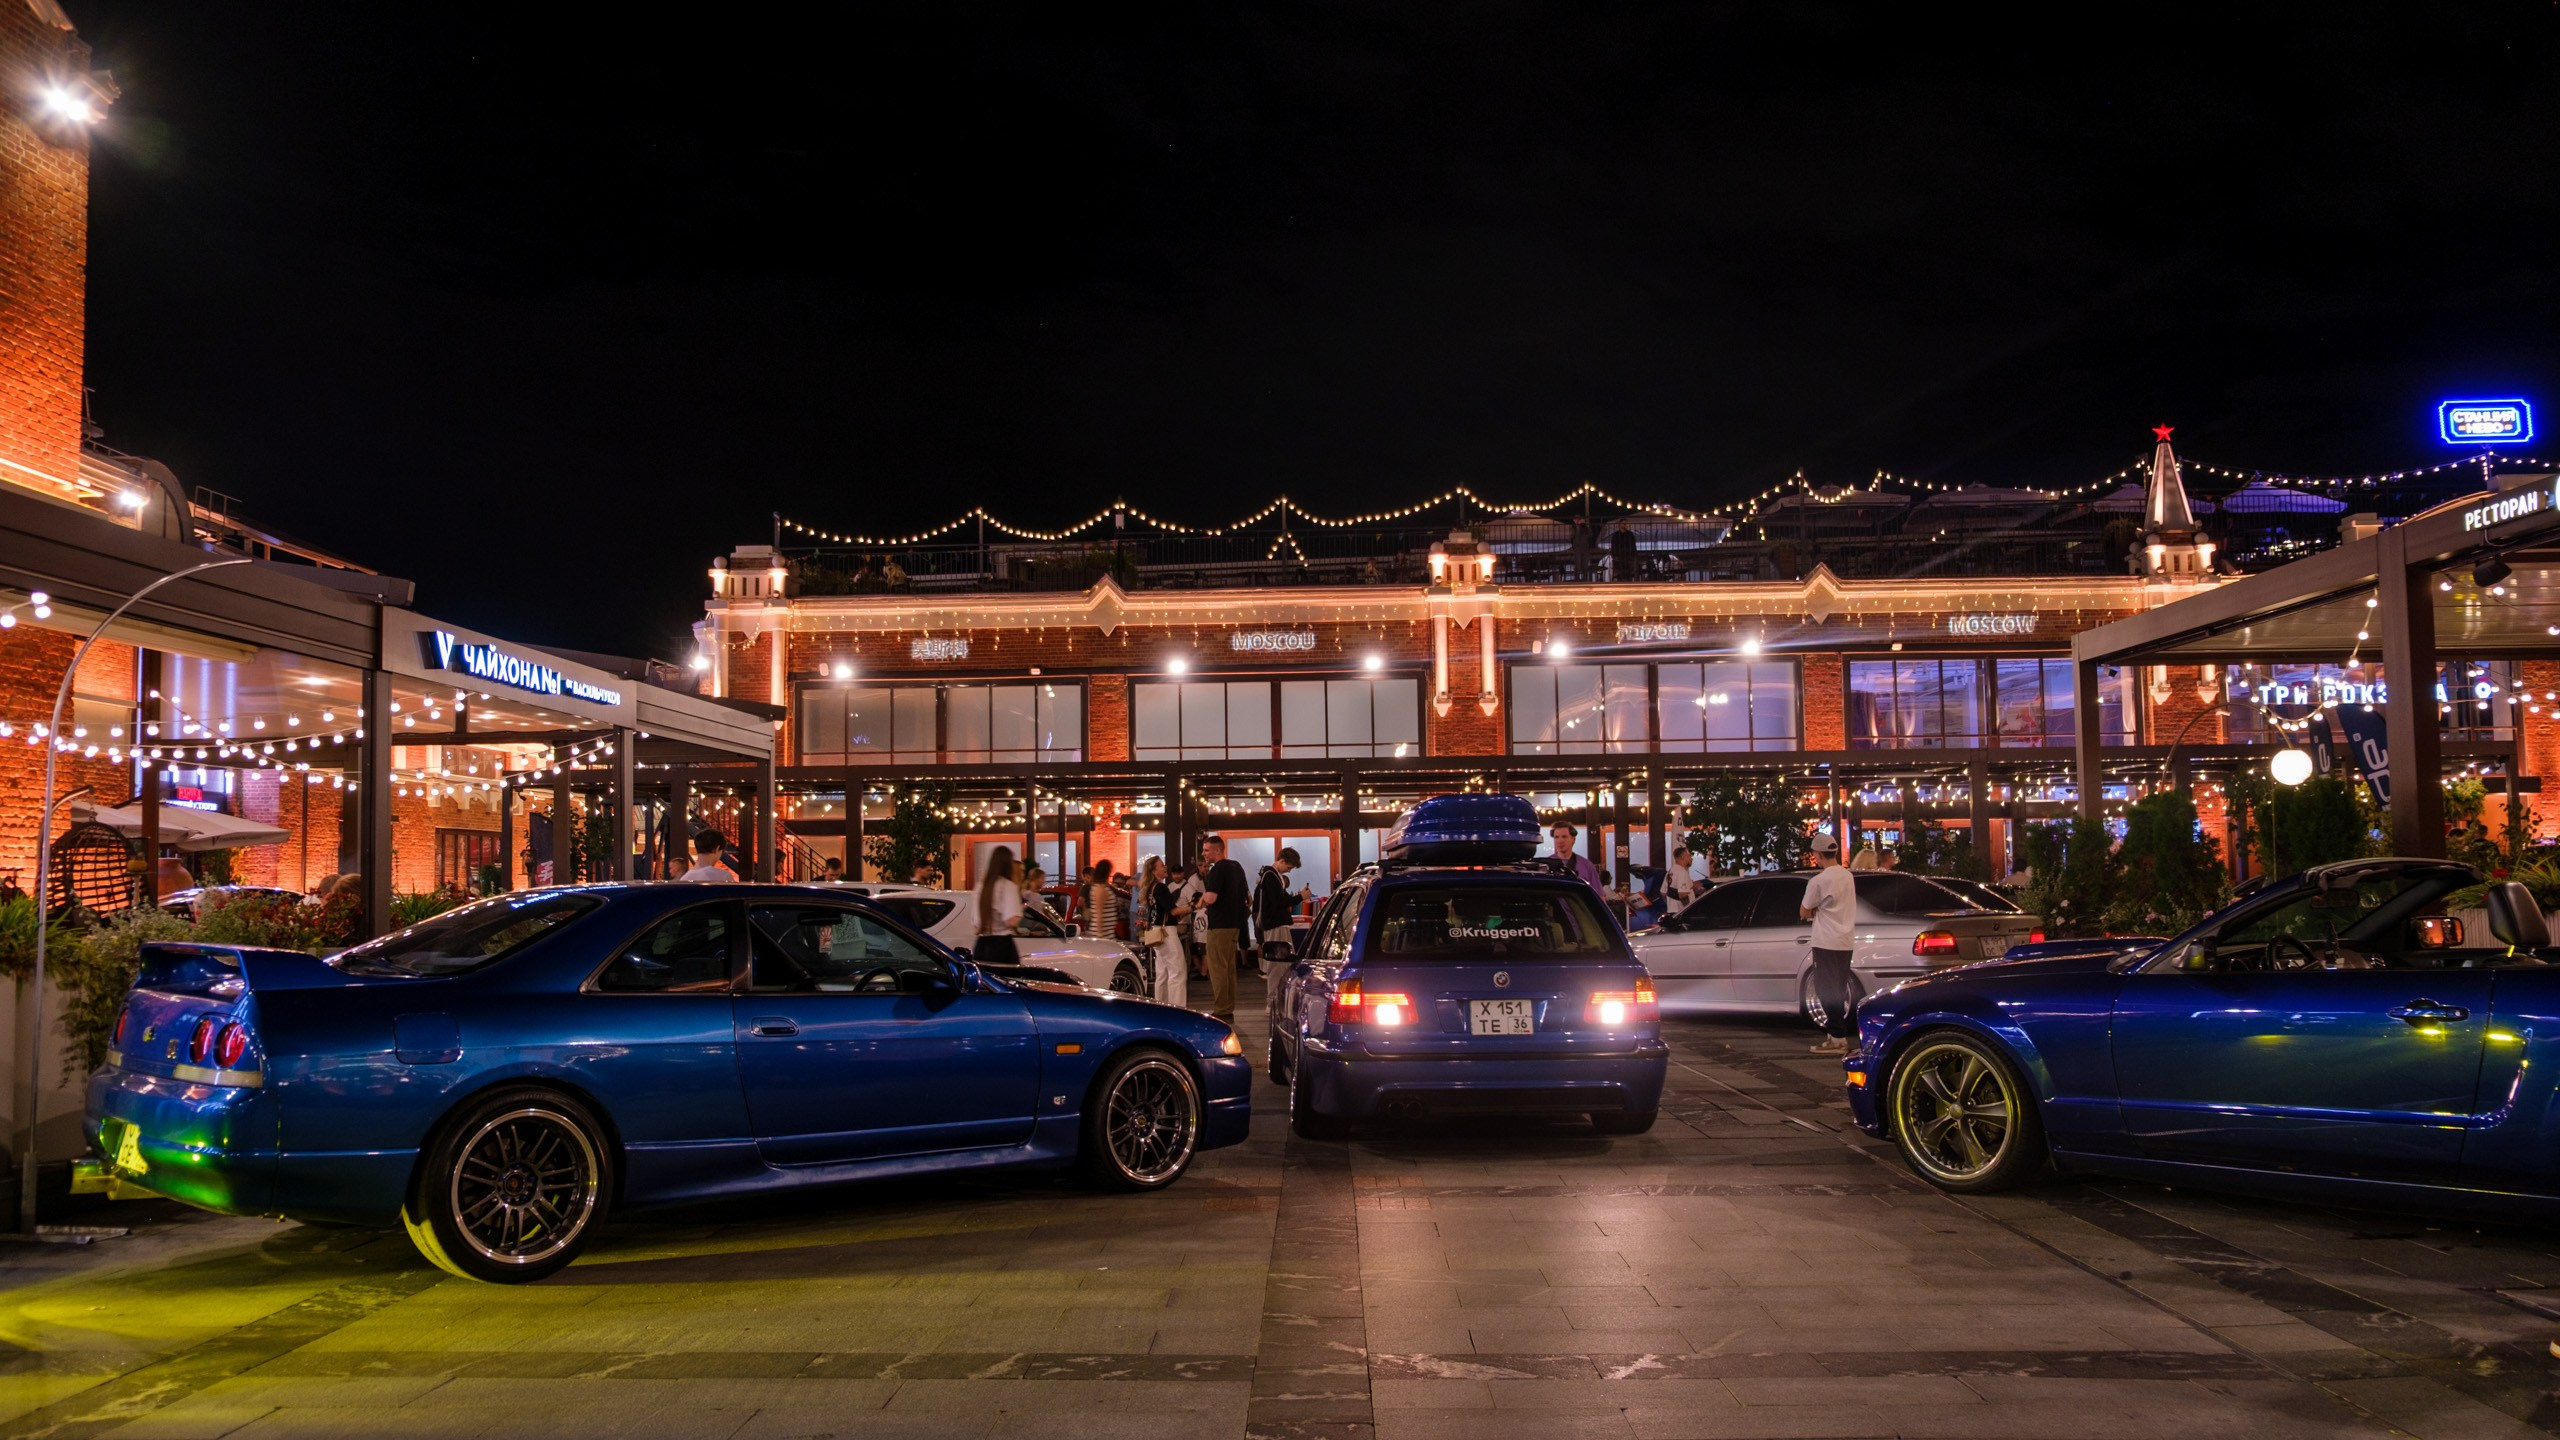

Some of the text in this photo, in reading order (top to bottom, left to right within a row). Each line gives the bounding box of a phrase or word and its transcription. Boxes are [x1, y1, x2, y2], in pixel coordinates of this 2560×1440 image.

[2465, 490, 2538, 531] РЕСТОРАН
[1949, 615, 2035, 635] MOSCOW
[911, 638, 968, 660] 莫斯科
[1232, 631, 1315, 650] MOSCOU
[2259, 685, 2308, 705] ТРИ
[1497, 1002, 1523, 1015] 151
[1479, 1018, 1528, 1033] ТЕ 36
